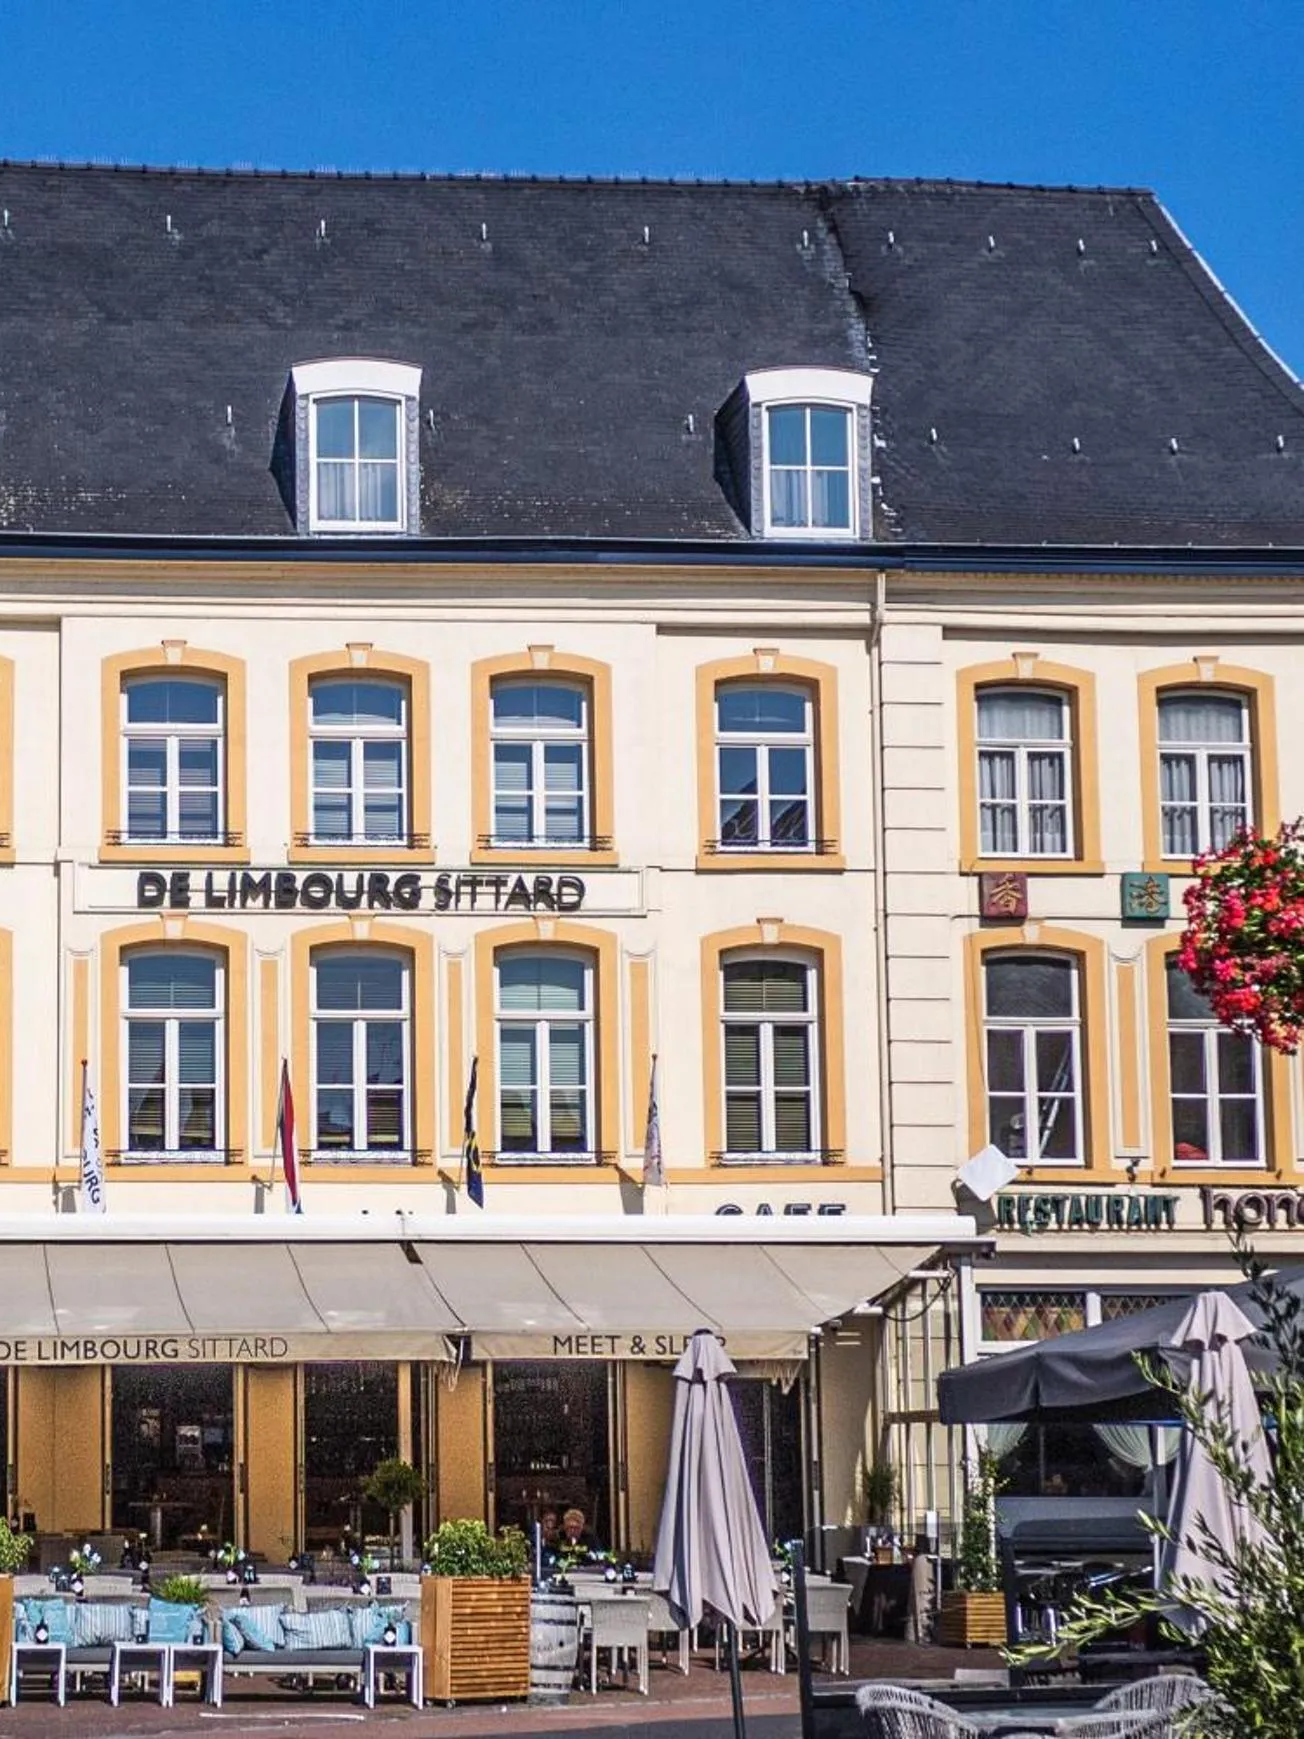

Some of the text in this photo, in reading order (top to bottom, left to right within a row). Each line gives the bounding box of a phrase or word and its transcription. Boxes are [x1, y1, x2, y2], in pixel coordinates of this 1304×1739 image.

[137, 872, 585, 911] DE LIMBOURG SITTARD
[997, 1184, 1304, 1227] RESTAURANT hon
[37, 1339, 179, 1360] LIMBOURG
[188, 1337, 288, 1359] SITTARD
[553, 1335, 621, 1356] MEET
[630, 1335, 646, 1356] &
